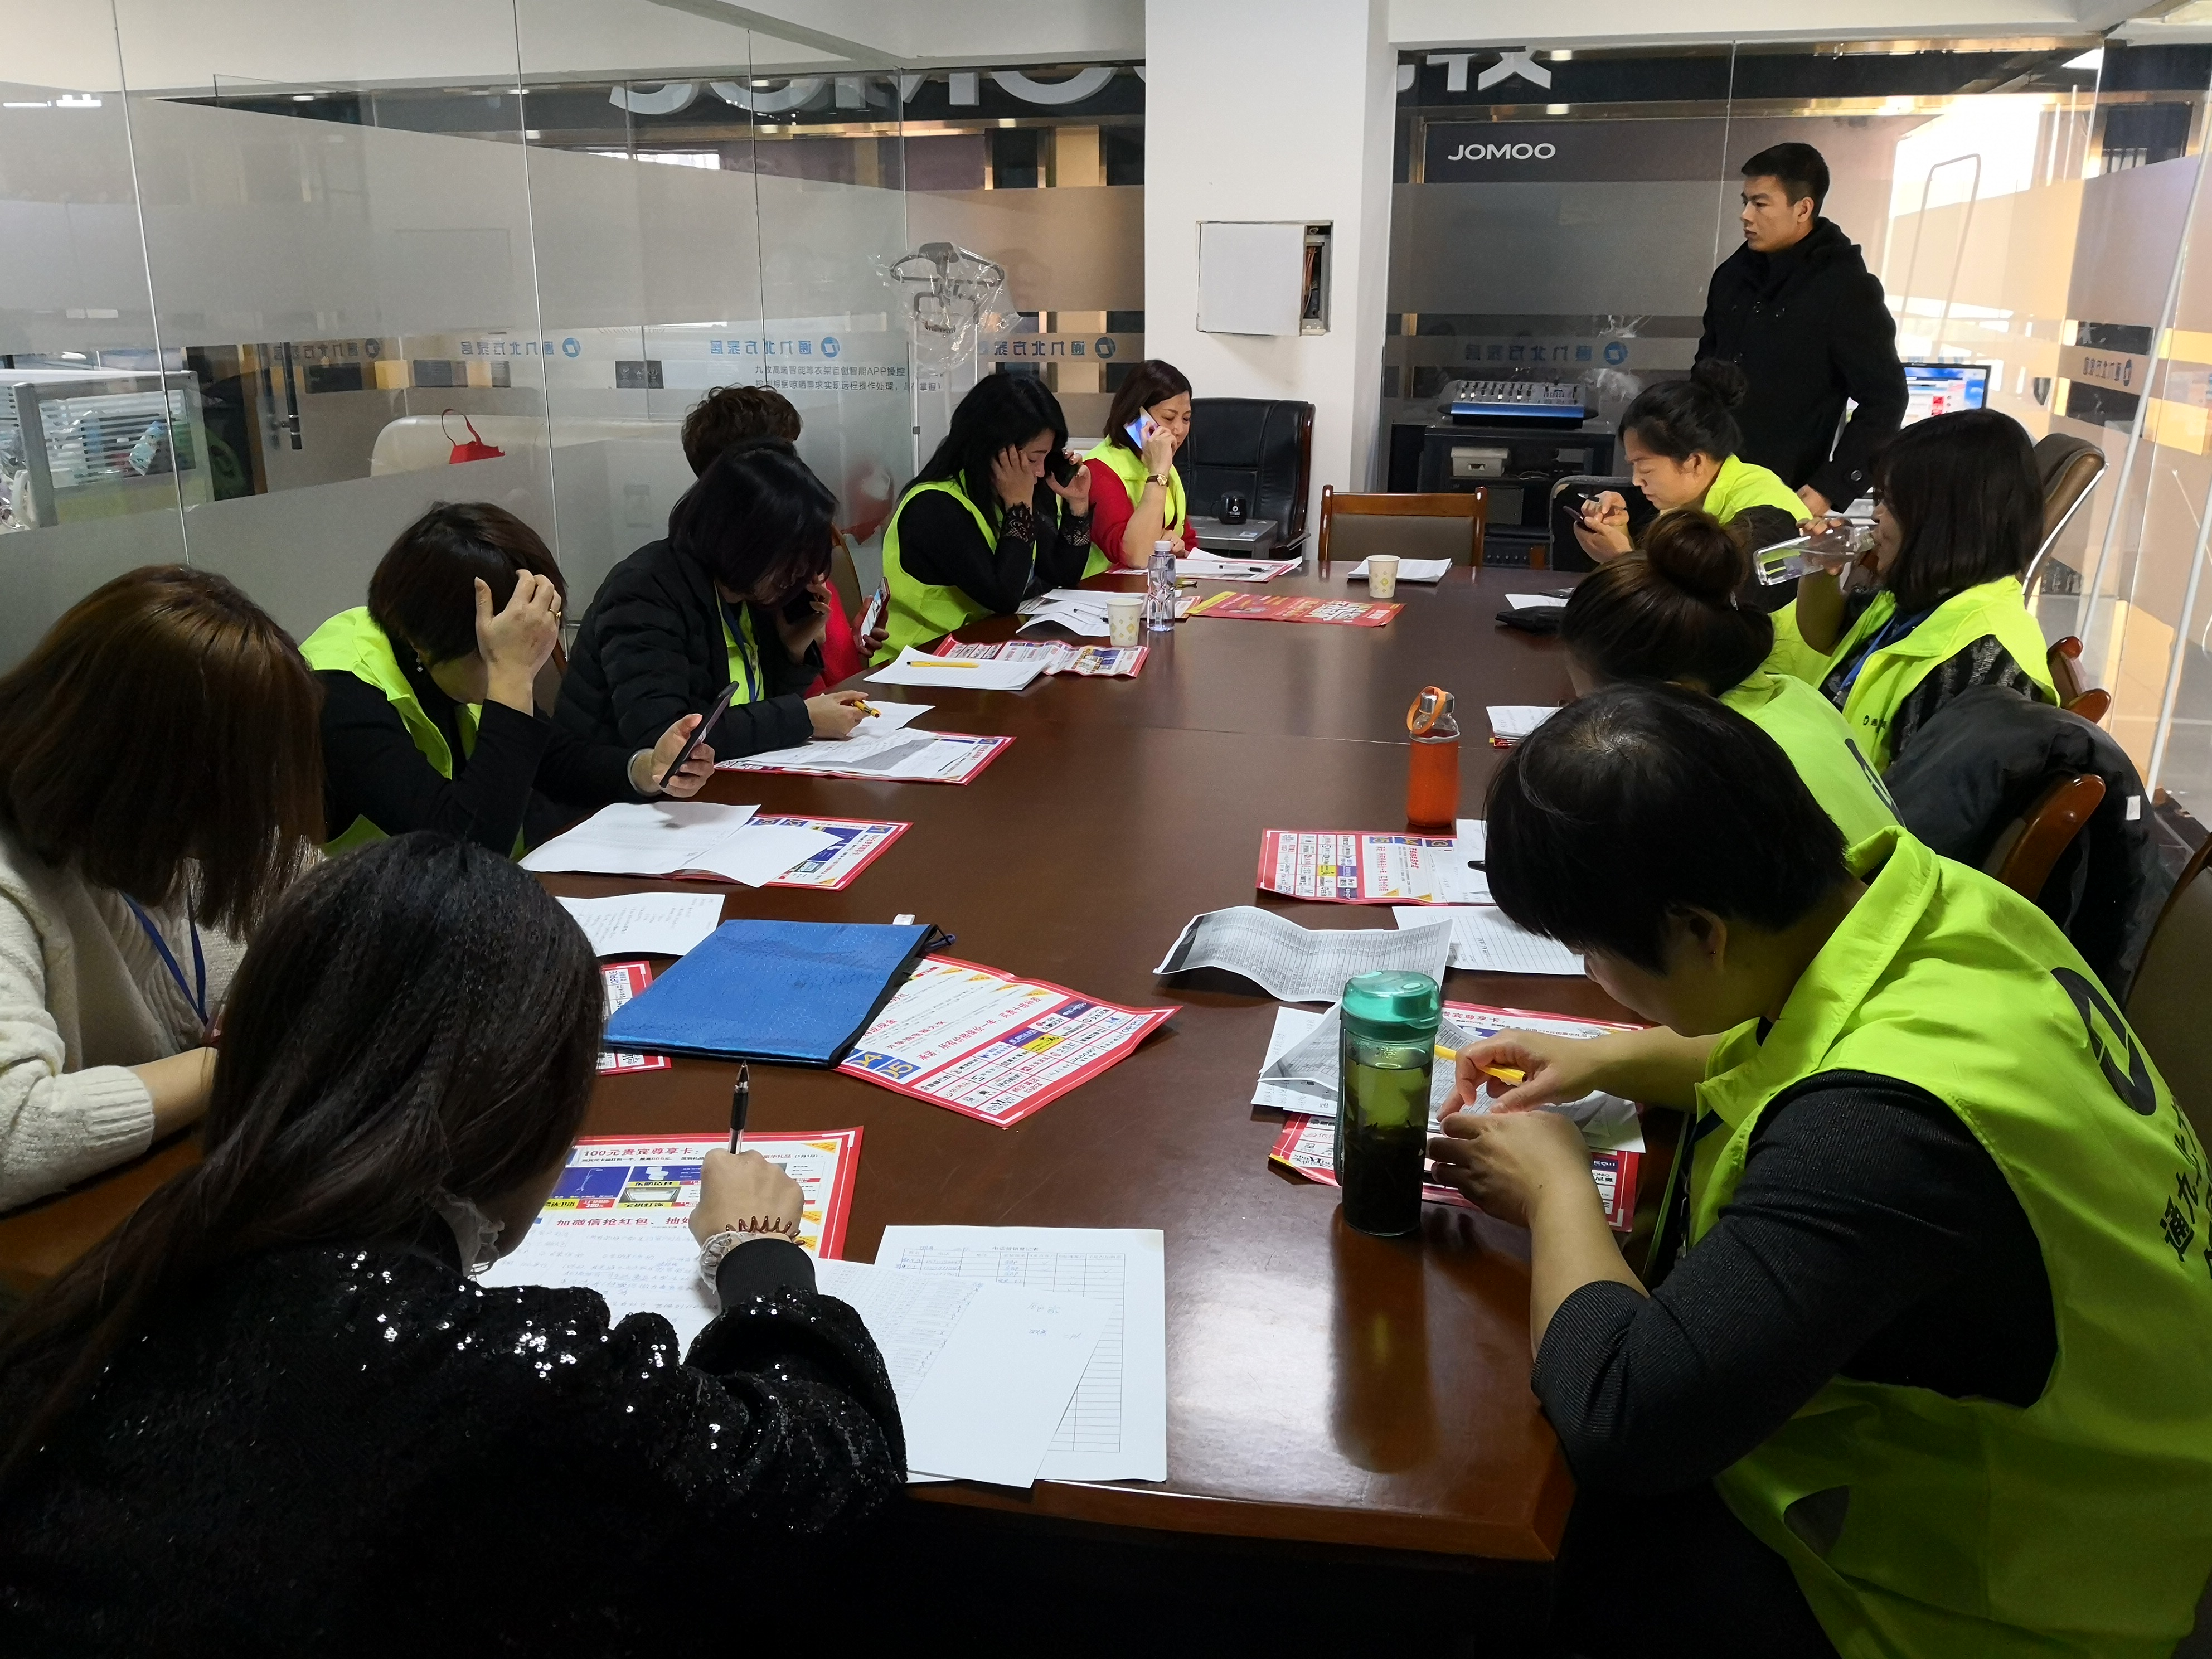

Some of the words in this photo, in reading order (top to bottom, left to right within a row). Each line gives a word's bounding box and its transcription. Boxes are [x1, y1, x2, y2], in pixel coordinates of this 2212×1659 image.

[1448, 143, 1556, 161] JOMOO
[609, 971, 619, 984] OPPLE
[584, 1147, 698, 1156] 100元贵宾尊享卡：
